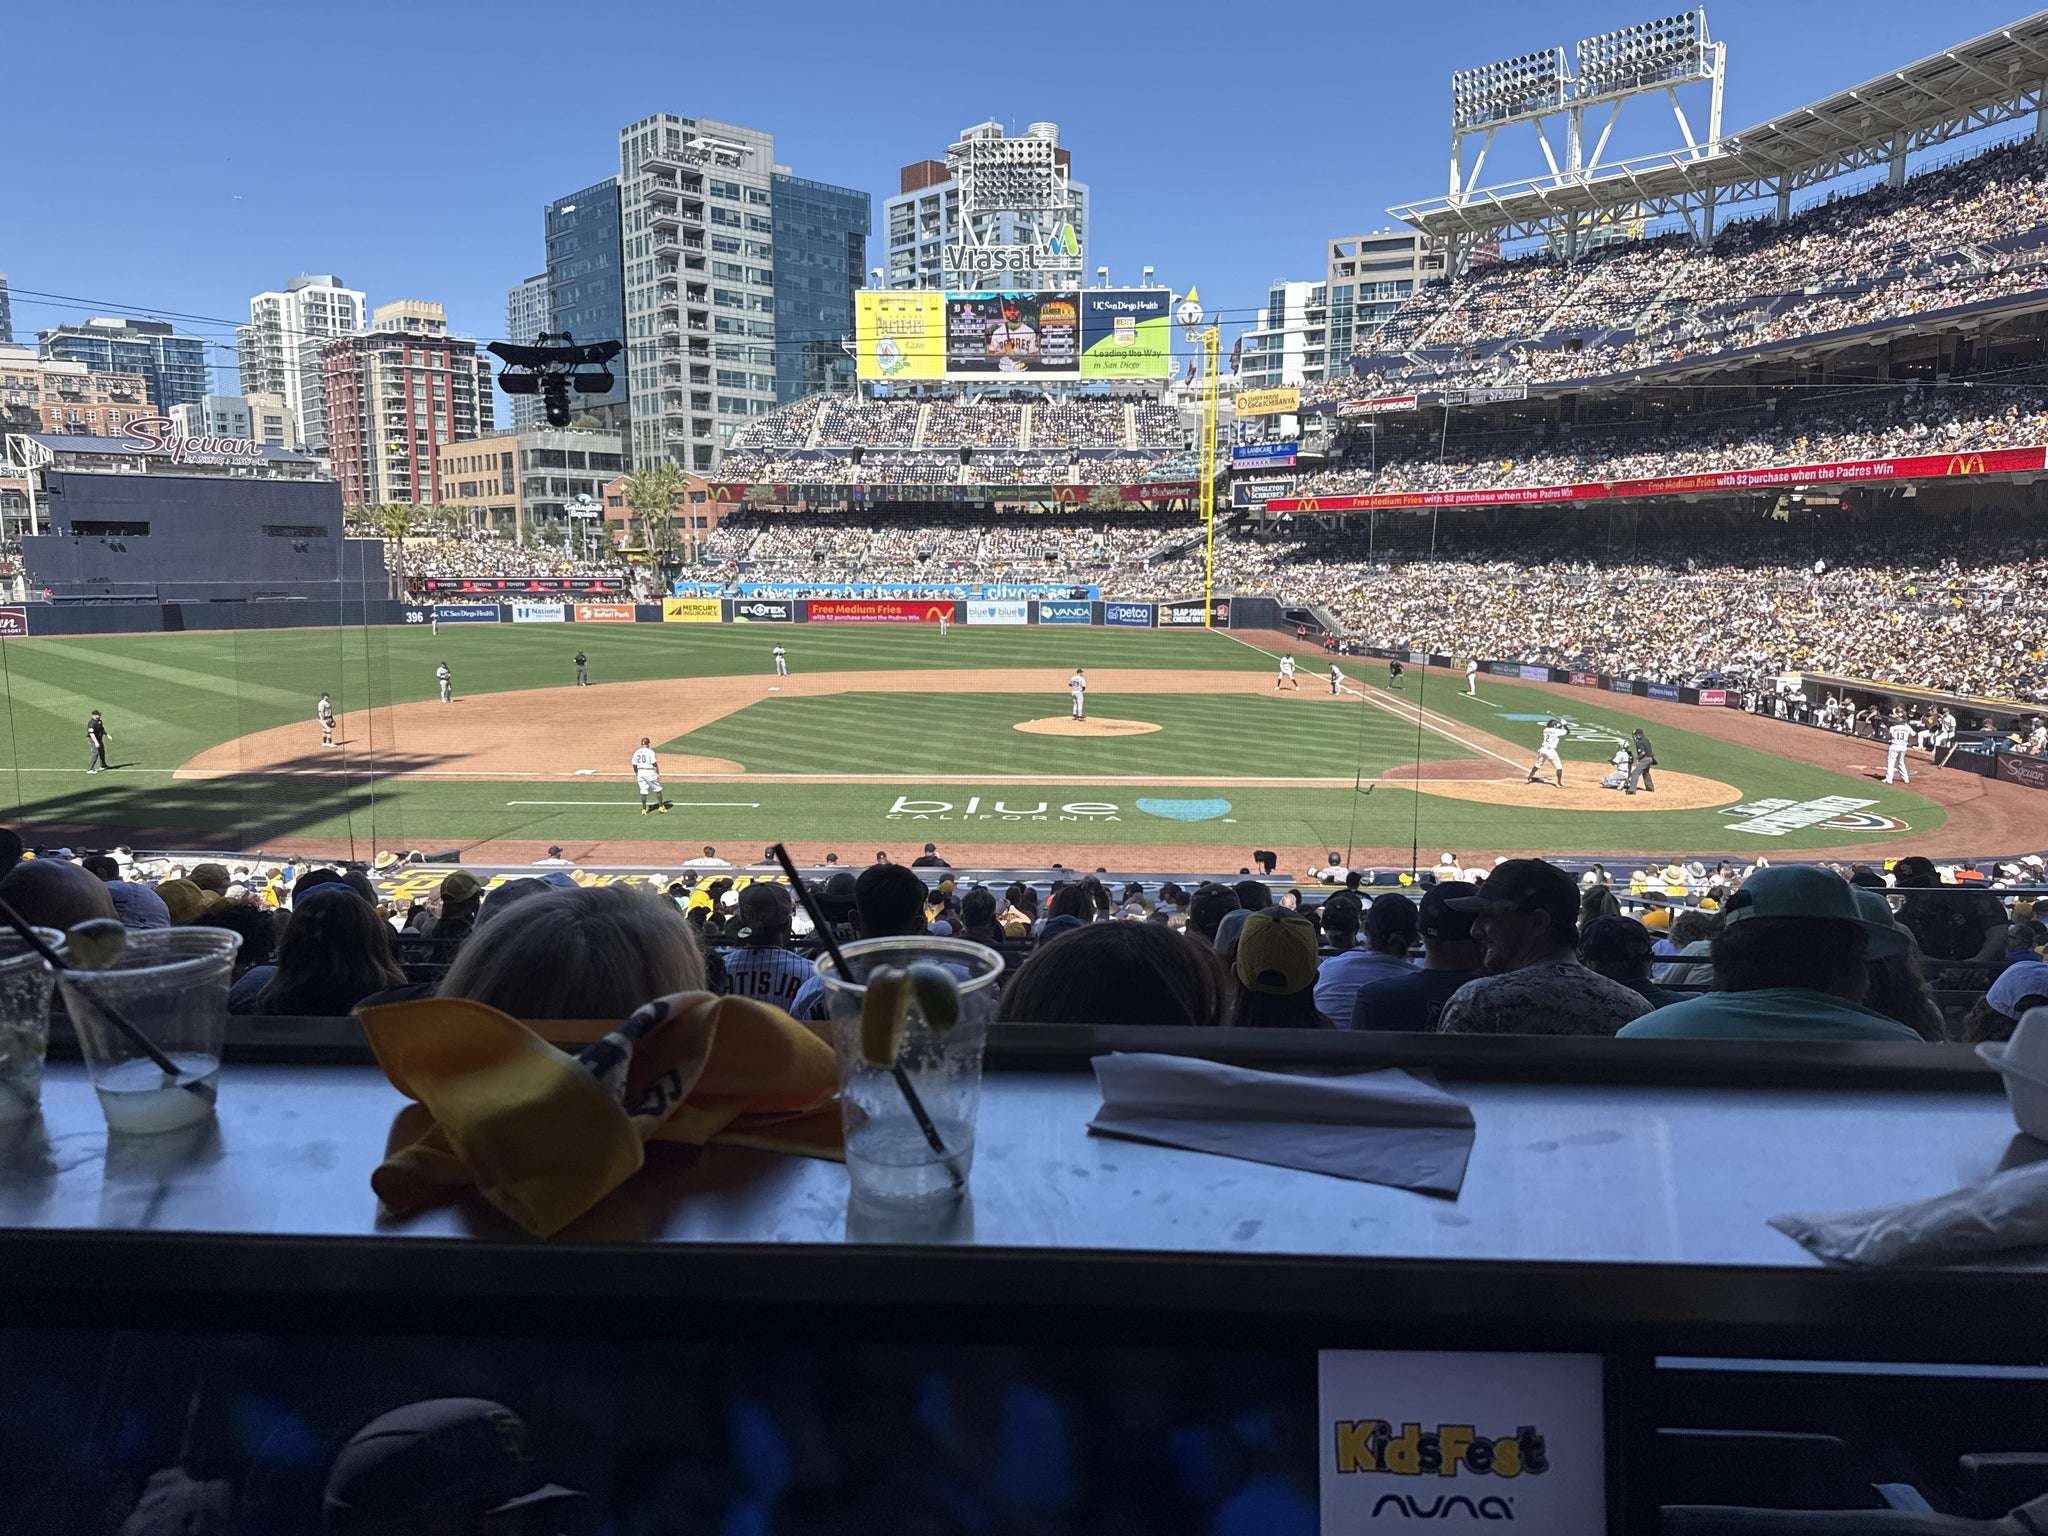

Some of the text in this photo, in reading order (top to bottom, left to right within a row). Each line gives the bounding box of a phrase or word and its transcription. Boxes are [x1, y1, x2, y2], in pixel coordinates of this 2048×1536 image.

[947, 244, 1040, 270] Viasat
[1093, 301, 1159, 312] UC San Diego Health
[1094, 350, 1162, 359] Leading the Way
[1094, 361, 1140, 369] in San Diego
[122, 416, 263, 464] Sycuan
[1648, 463, 1894, 491] Free Medium Fries with $2 purchase when the Padres Win
[1152, 486, 1191, 497] Budweiser
[1251, 484, 1285, 492] SINGLETON
[1353, 487, 1573, 507] Free Medium Fries with $2 purchase when the Padres Win
[570, 511, 599, 519] Square
[461, 610, 477, 618] Diego
[740, 604, 786, 616] EVOTEK
[812, 604, 901, 614] Free Medium Fries
[969, 607, 988, 616] blue
[998, 607, 1017, 616] blue
[1053, 608, 1091, 616] VANDA
[1119, 606, 1148, 620] petco
[1173, 608, 1188, 616] SLAP
[406, 611, 424, 623] 396
[1896, 731, 1905, 741] 13
[637, 754, 647, 764] 20
[2007, 759, 2045, 785] Sycuan
[889, 796, 1120, 815] blue
[885, 814, 1123, 822] CALIFORNIA
[1334, 1420, 1550, 1478] KidsFest
[1371, 1494, 1514, 1520] nuna
